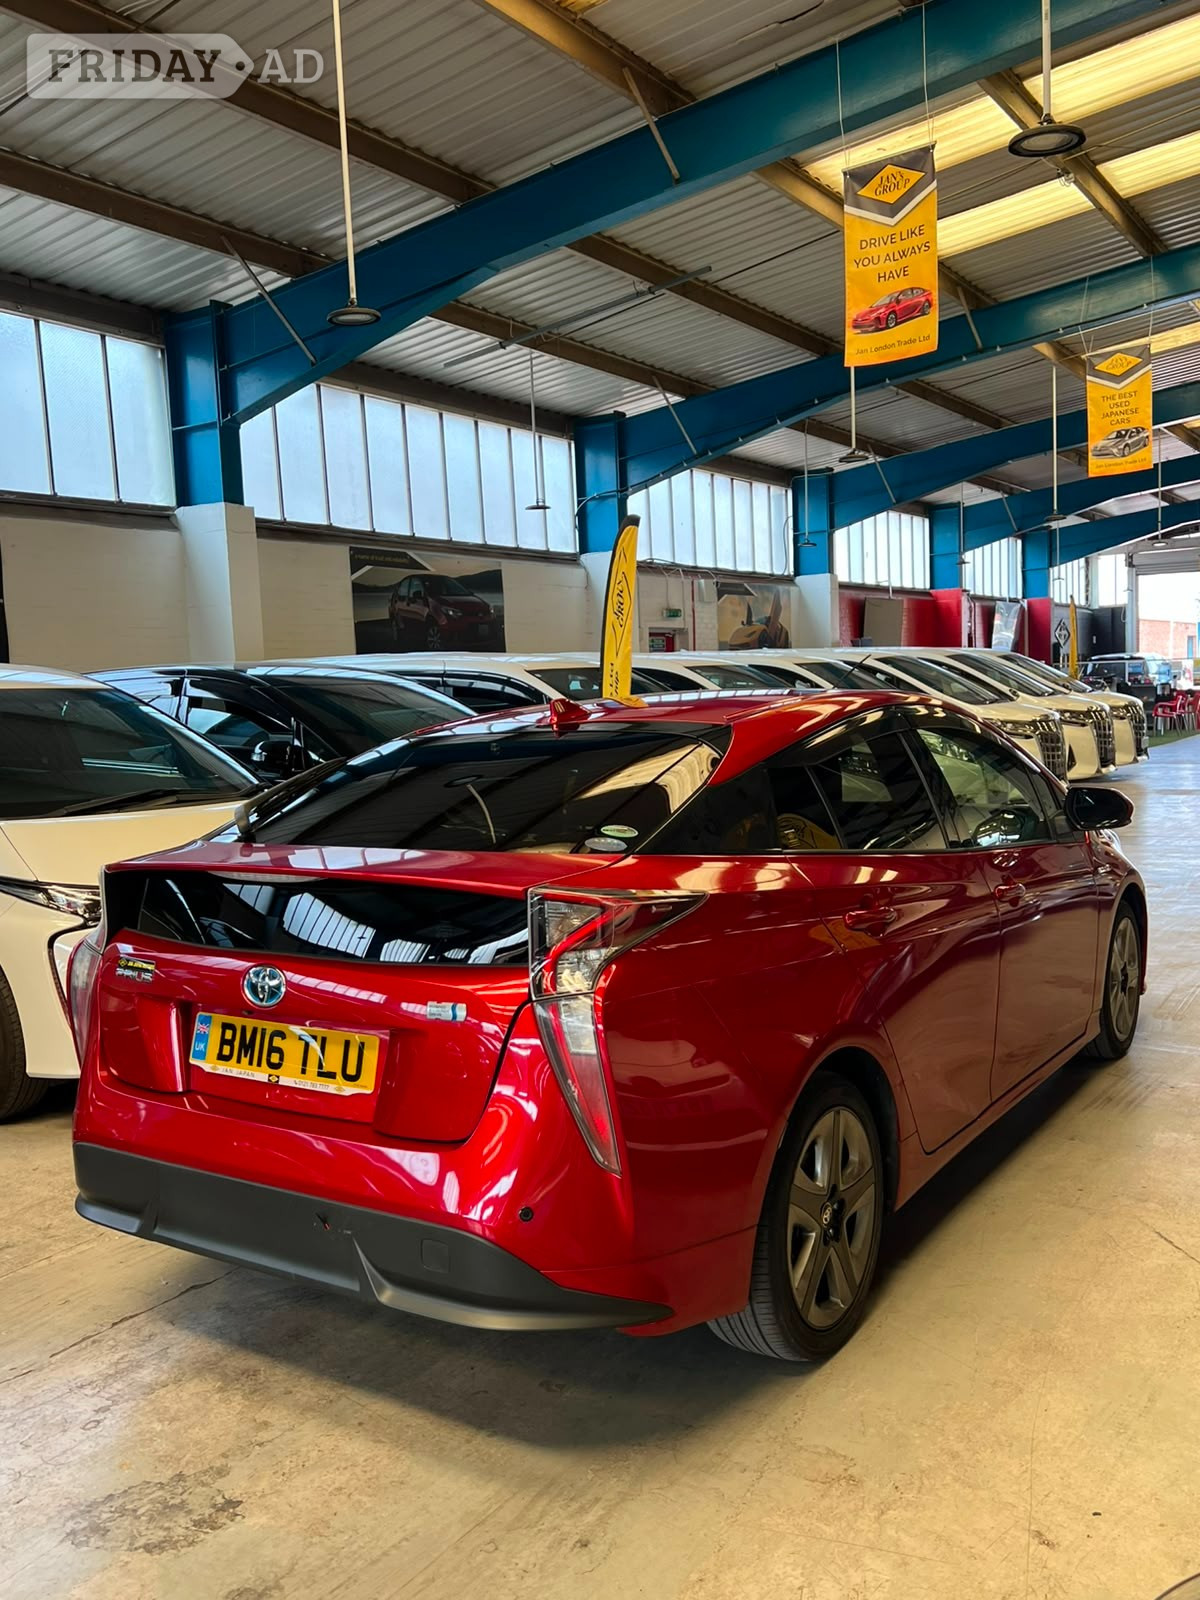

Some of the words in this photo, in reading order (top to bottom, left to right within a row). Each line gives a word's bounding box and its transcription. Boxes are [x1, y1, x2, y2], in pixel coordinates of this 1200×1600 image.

[874, 178, 911, 197] GROUP
[859, 232, 897, 250] DRIVE
[899, 224, 925, 241] LIKE
[853, 254, 881, 269] YOU
[883, 241, 931, 263] ALWAYS
[877, 265, 910, 283] HAVE
[870, 342, 896, 353] London
[896, 337, 917, 347] Trade
[918, 334, 931, 343] Ltd
[1101, 393, 1117, 402] THE
[1118, 390, 1138, 400] BEST
[1101, 407, 1140, 419] JAPANESE
[1108, 400, 1131, 410] USED
[1109, 417, 1131, 427] CARS
[115, 967, 153, 984] PRIUS
[194, 1042, 206, 1052] UK
[216, 1021, 287, 1071] BM16
[298, 1032, 366, 1083] TLU
